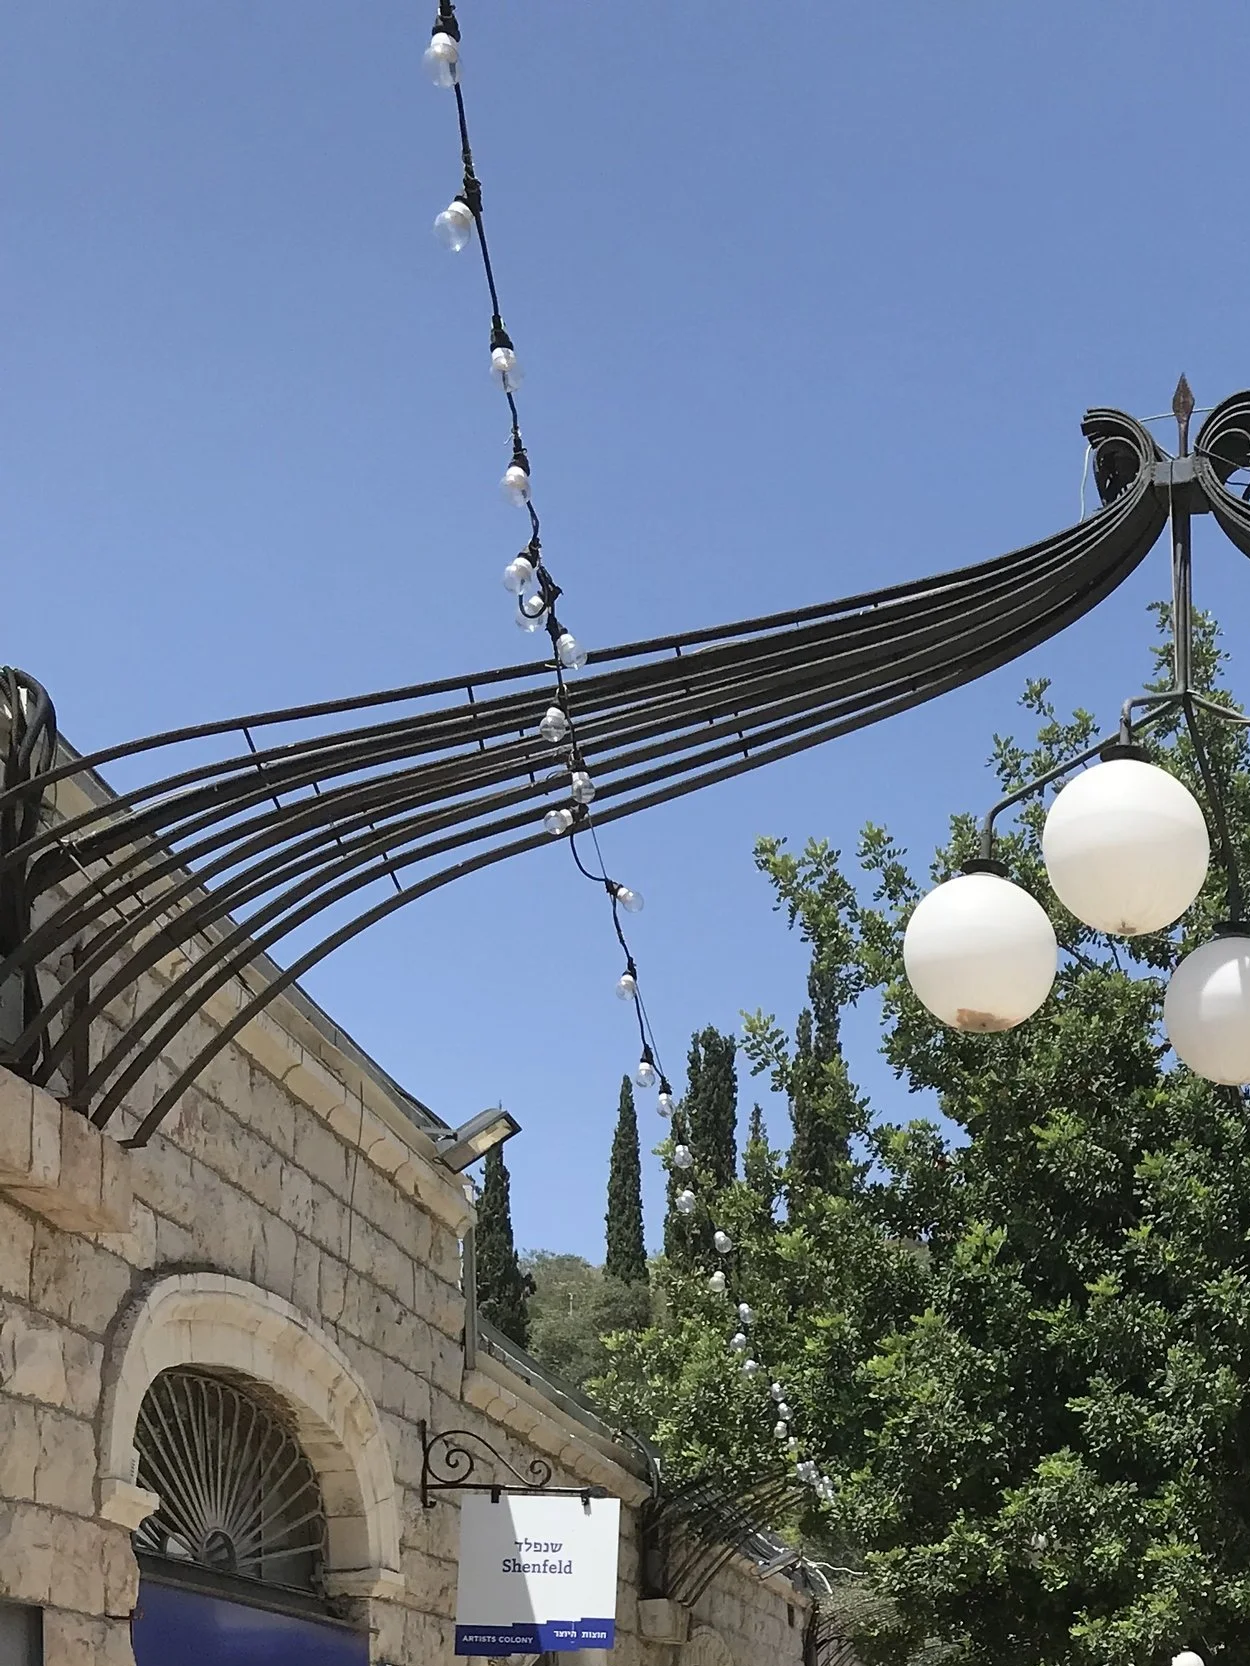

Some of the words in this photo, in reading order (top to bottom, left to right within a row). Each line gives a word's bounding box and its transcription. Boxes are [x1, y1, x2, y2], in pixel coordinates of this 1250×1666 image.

[514, 1538, 563, 1553] שנפלד
[502, 1559, 573, 1574] Shenfeld
[462, 1635, 497, 1643] ARTISTS
[498, 1635, 534, 1644] COLONY
